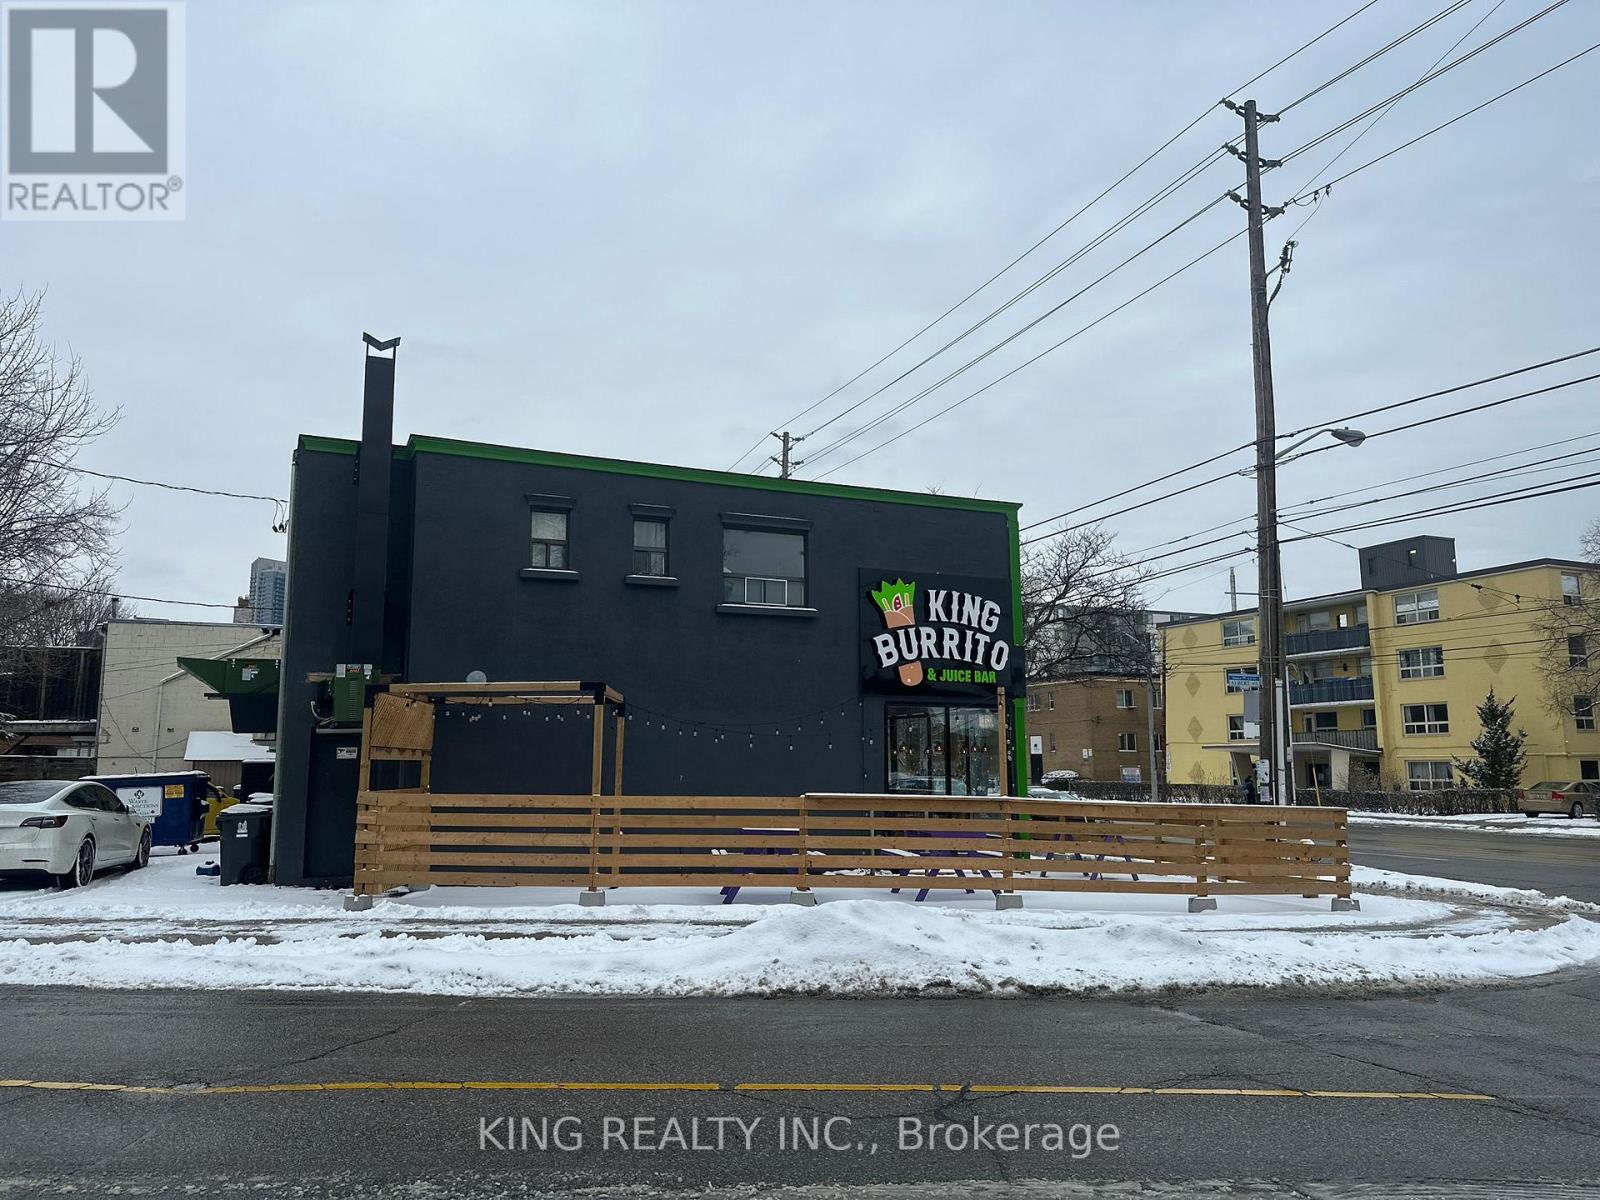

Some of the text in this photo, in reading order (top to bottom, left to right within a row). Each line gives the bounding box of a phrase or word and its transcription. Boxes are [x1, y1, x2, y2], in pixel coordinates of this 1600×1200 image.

[927, 589, 1001, 633] KING
[873, 626, 1010, 671] BURRITO
[927, 667, 997, 683] & JUICE BAR
